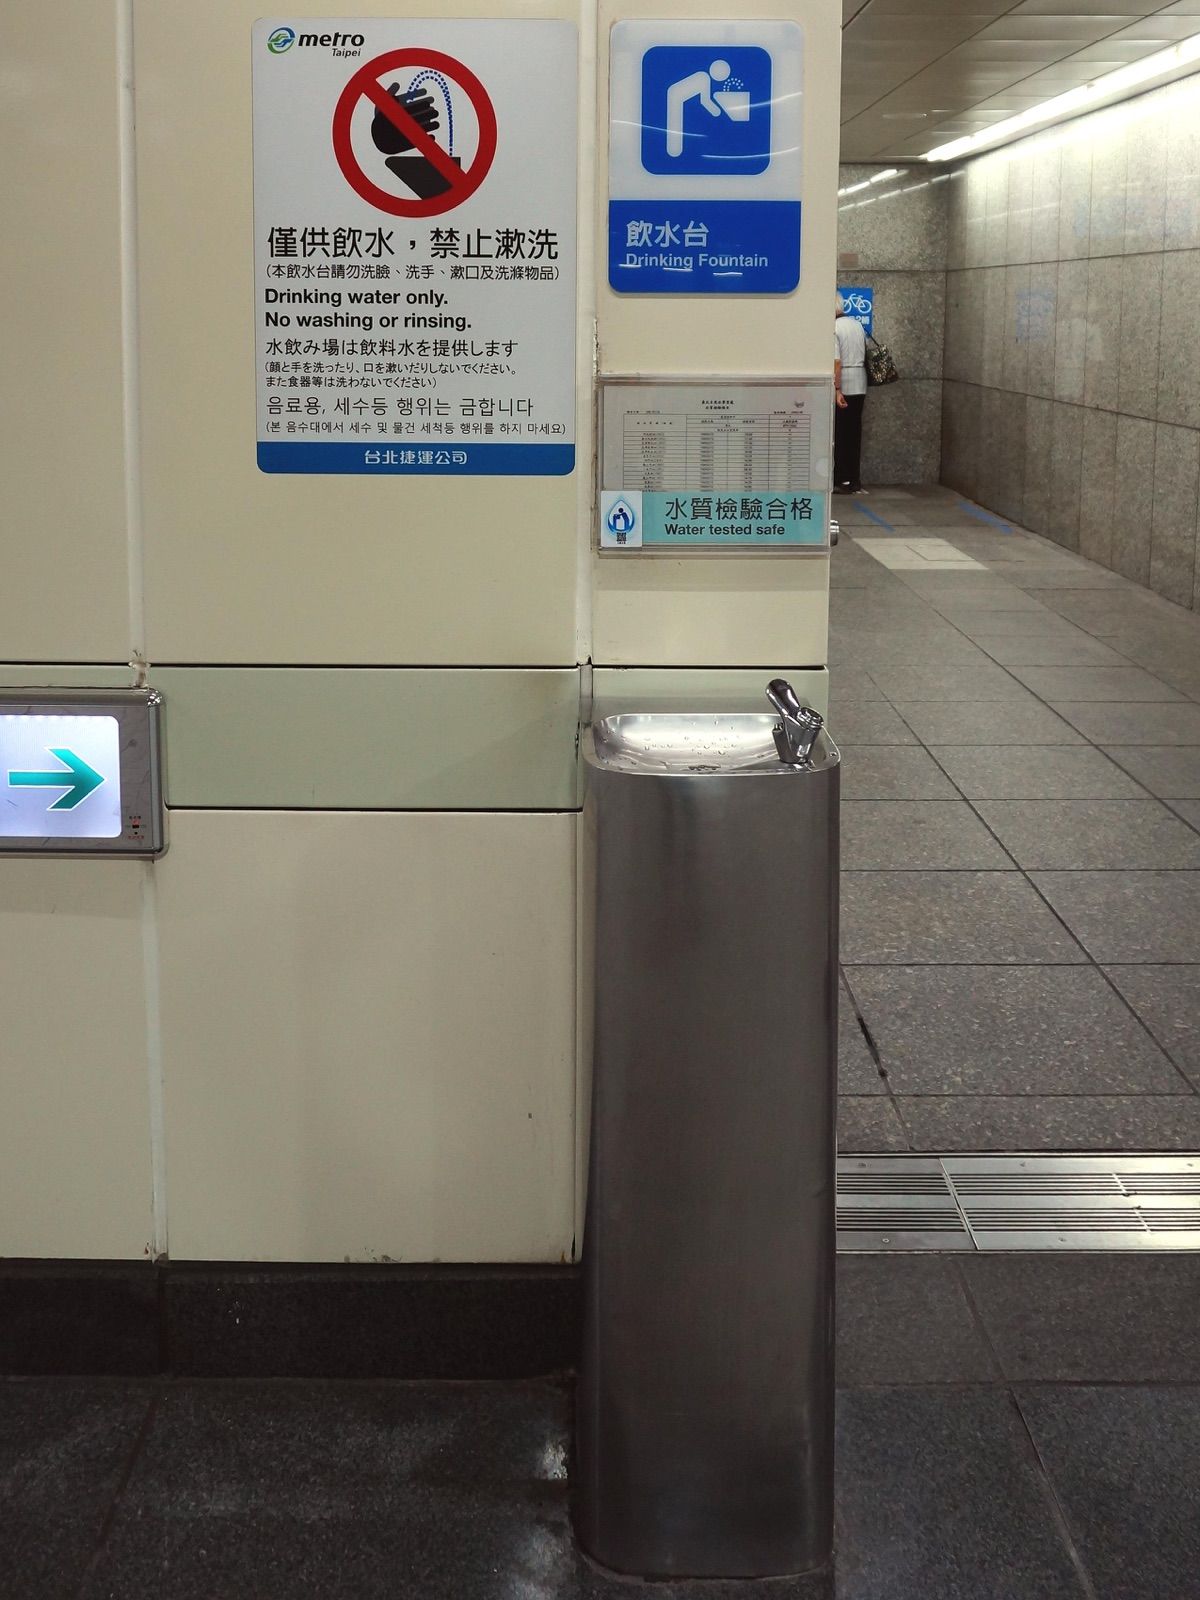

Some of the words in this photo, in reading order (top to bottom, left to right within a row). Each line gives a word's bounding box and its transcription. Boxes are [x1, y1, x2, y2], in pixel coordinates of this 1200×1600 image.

[298, 32, 365, 47] metro
[332, 48, 361, 58] Taipei
[626, 220, 709, 248] 飲水台
[626, 253, 693, 269] Drinking
[698, 253, 768, 267] Fountain
[265, 288, 342, 308] Drinking
[347, 290, 401, 304] water
[406, 289, 448, 308] only.
[265, 312, 291, 327] No
[296, 312, 373, 331] washing
[379, 315, 399, 328] or
[404, 312, 472, 332] rinsing.
[265, 338, 518, 358] 水飲み場は飲料水を提供します
[266, 396, 326, 415] 음료용,
[333, 397, 389, 416] 세수등
[396, 397, 451, 416] 행위는
[459, 397, 534, 417] 금합니다
[266, 421, 281, 433] (본
[286, 421, 344, 434] 음수대에서
[349, 421, 372, 434] 세수
[377, 422, 388, 434] 및
[392, 422, 415, 434] 물건
[420, 422, 455, 435] 세척등
[460, 422, 495, 435] 행위를
[499, 422, 522, 435] 하지
[527, 423, 566, 435] 마세요)
[364, 450, 468, 465] 台北捷運公司
[665, 497, 813, 521] 水質檢驗合格
[665, 524, 704, 535] Water
[709, 523, 752, 535] tested
[756, 523, 785, 535] safe
